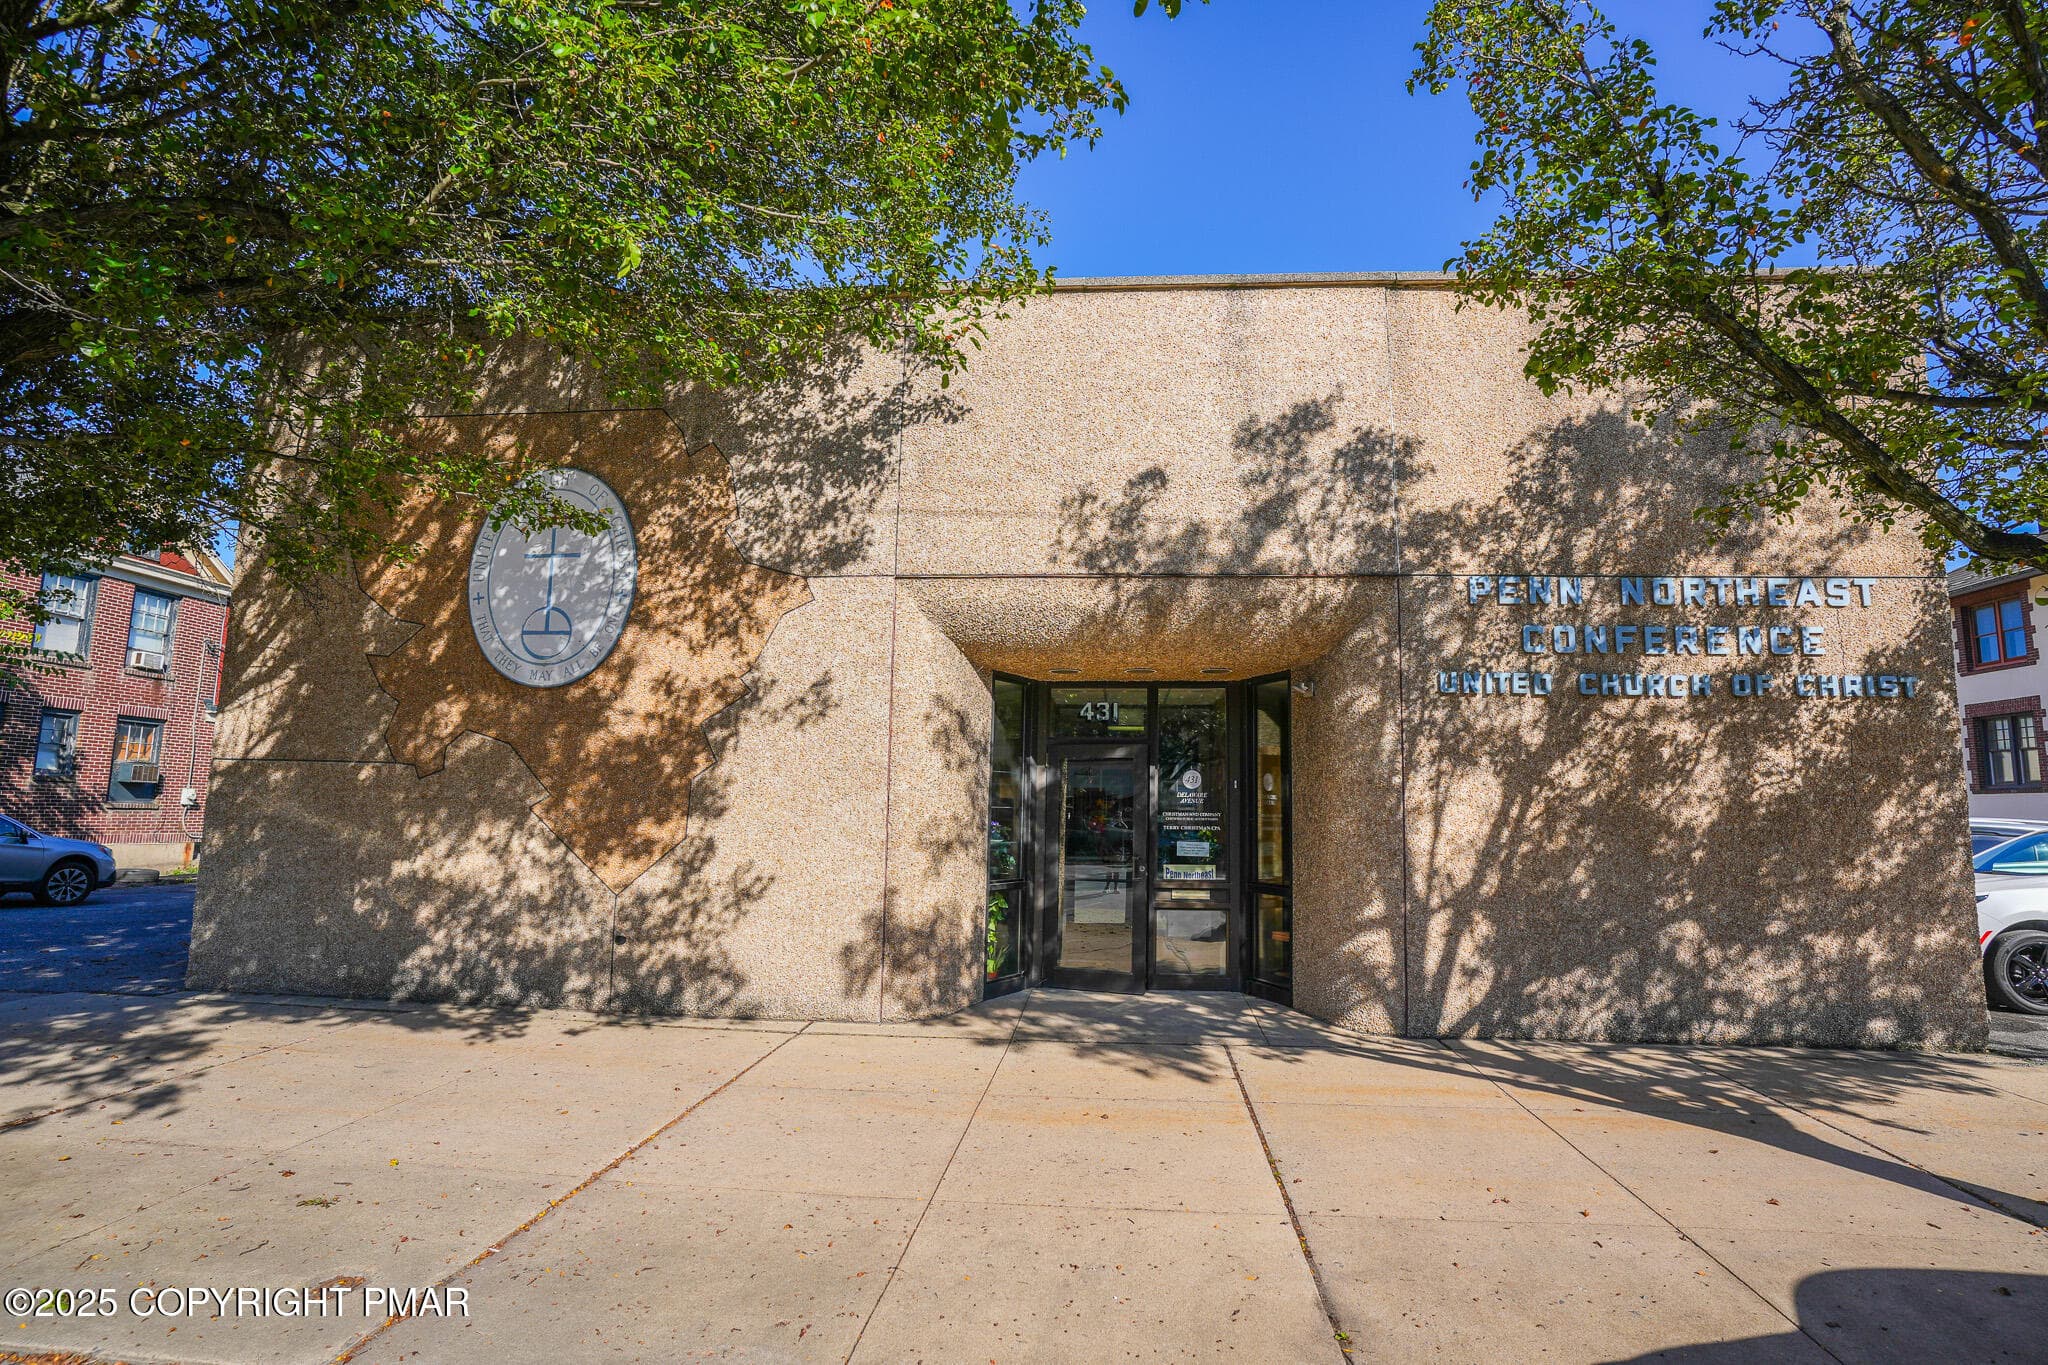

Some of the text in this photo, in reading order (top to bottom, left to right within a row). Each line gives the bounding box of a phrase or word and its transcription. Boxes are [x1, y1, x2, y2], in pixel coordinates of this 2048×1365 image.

[589, 484, 608, 502] OF
[1468, 576, 1878, 608] PENN NORTHEAST
[477, 613, 494, 642] THAT
[494, 651, 522, 675] THEY
[529, 669, 553, 681] MAY
[565, 660, 585, 675] ALL
[590, 642, 605, 658] BE
[1522, 624, 1827, 656] CONFERENCE
[1439, 671, 1919, 698] UNITED CHURCH OF CHRIST
[1079, 702, 1118, 721] 431
[1165, 867, 1214, 879] Penn Northeast
